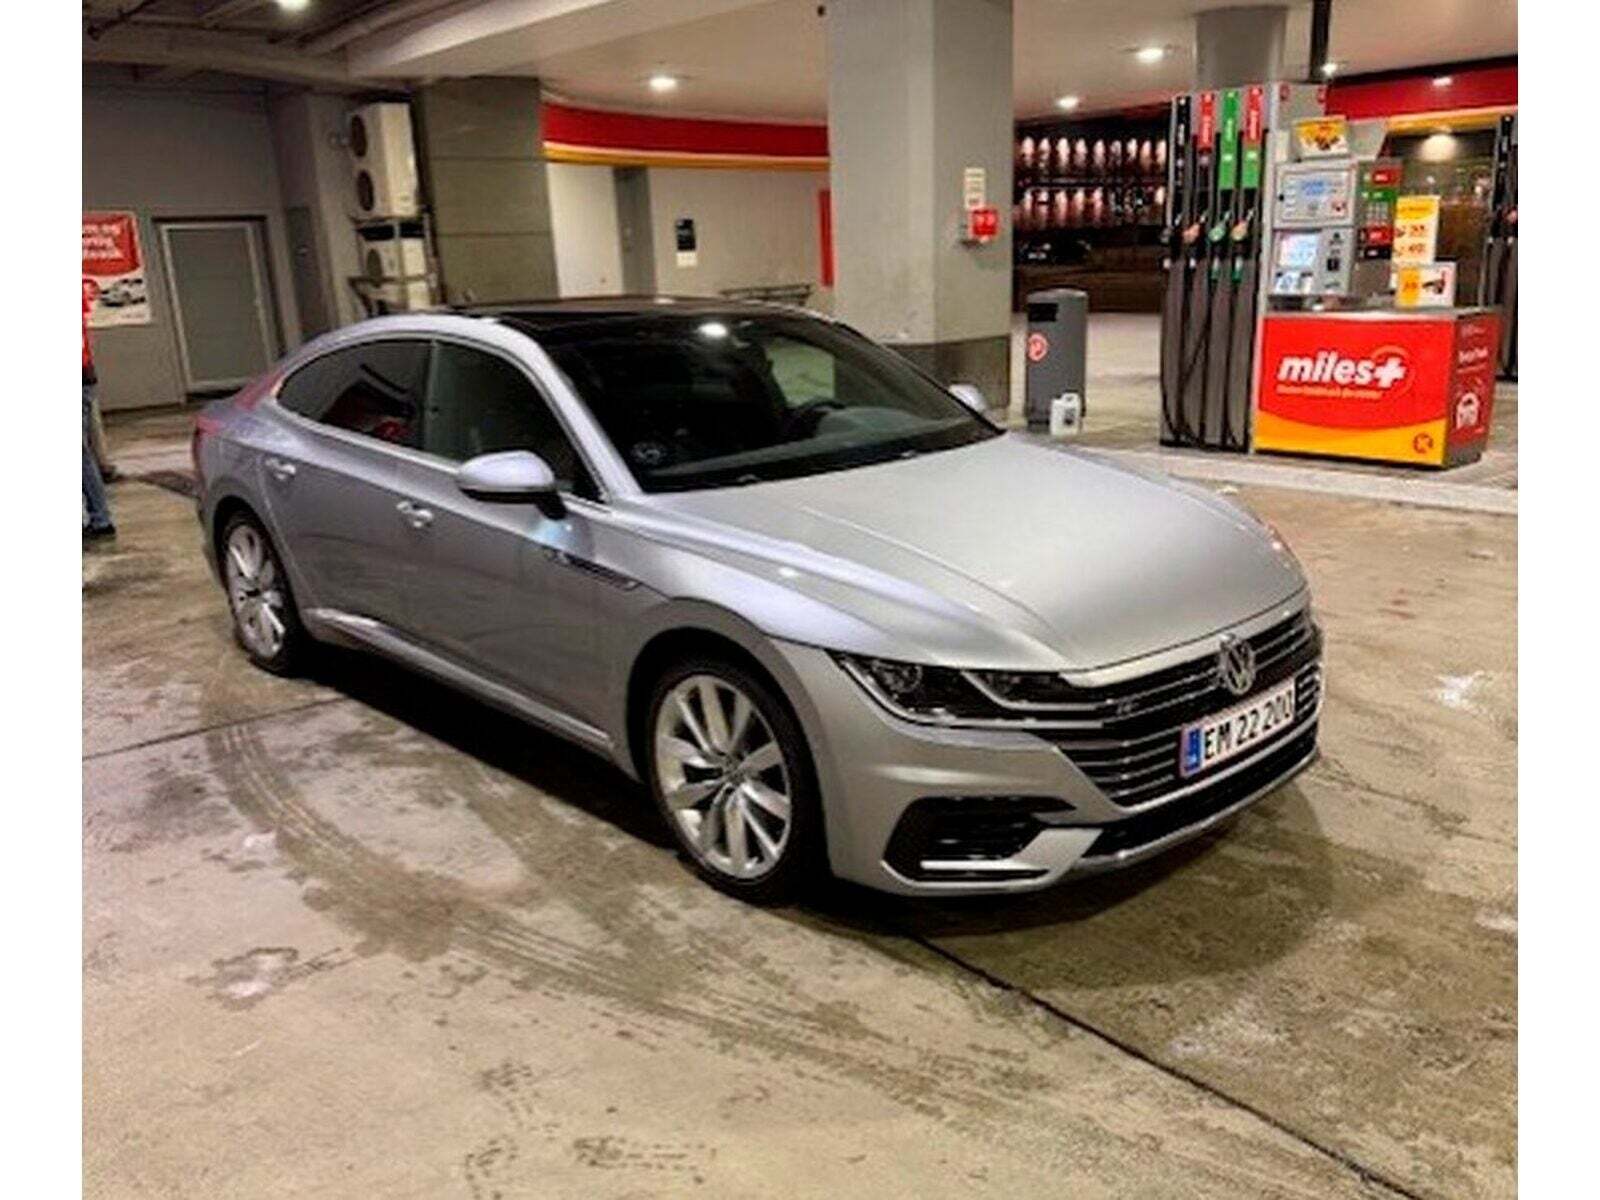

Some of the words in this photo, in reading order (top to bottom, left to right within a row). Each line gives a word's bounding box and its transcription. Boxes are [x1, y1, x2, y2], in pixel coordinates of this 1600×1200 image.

[1277, 351, 1408, 388] miles+
[1205, 722, 1231, 759] EM
[1237, 708, 1258, 744] 22
